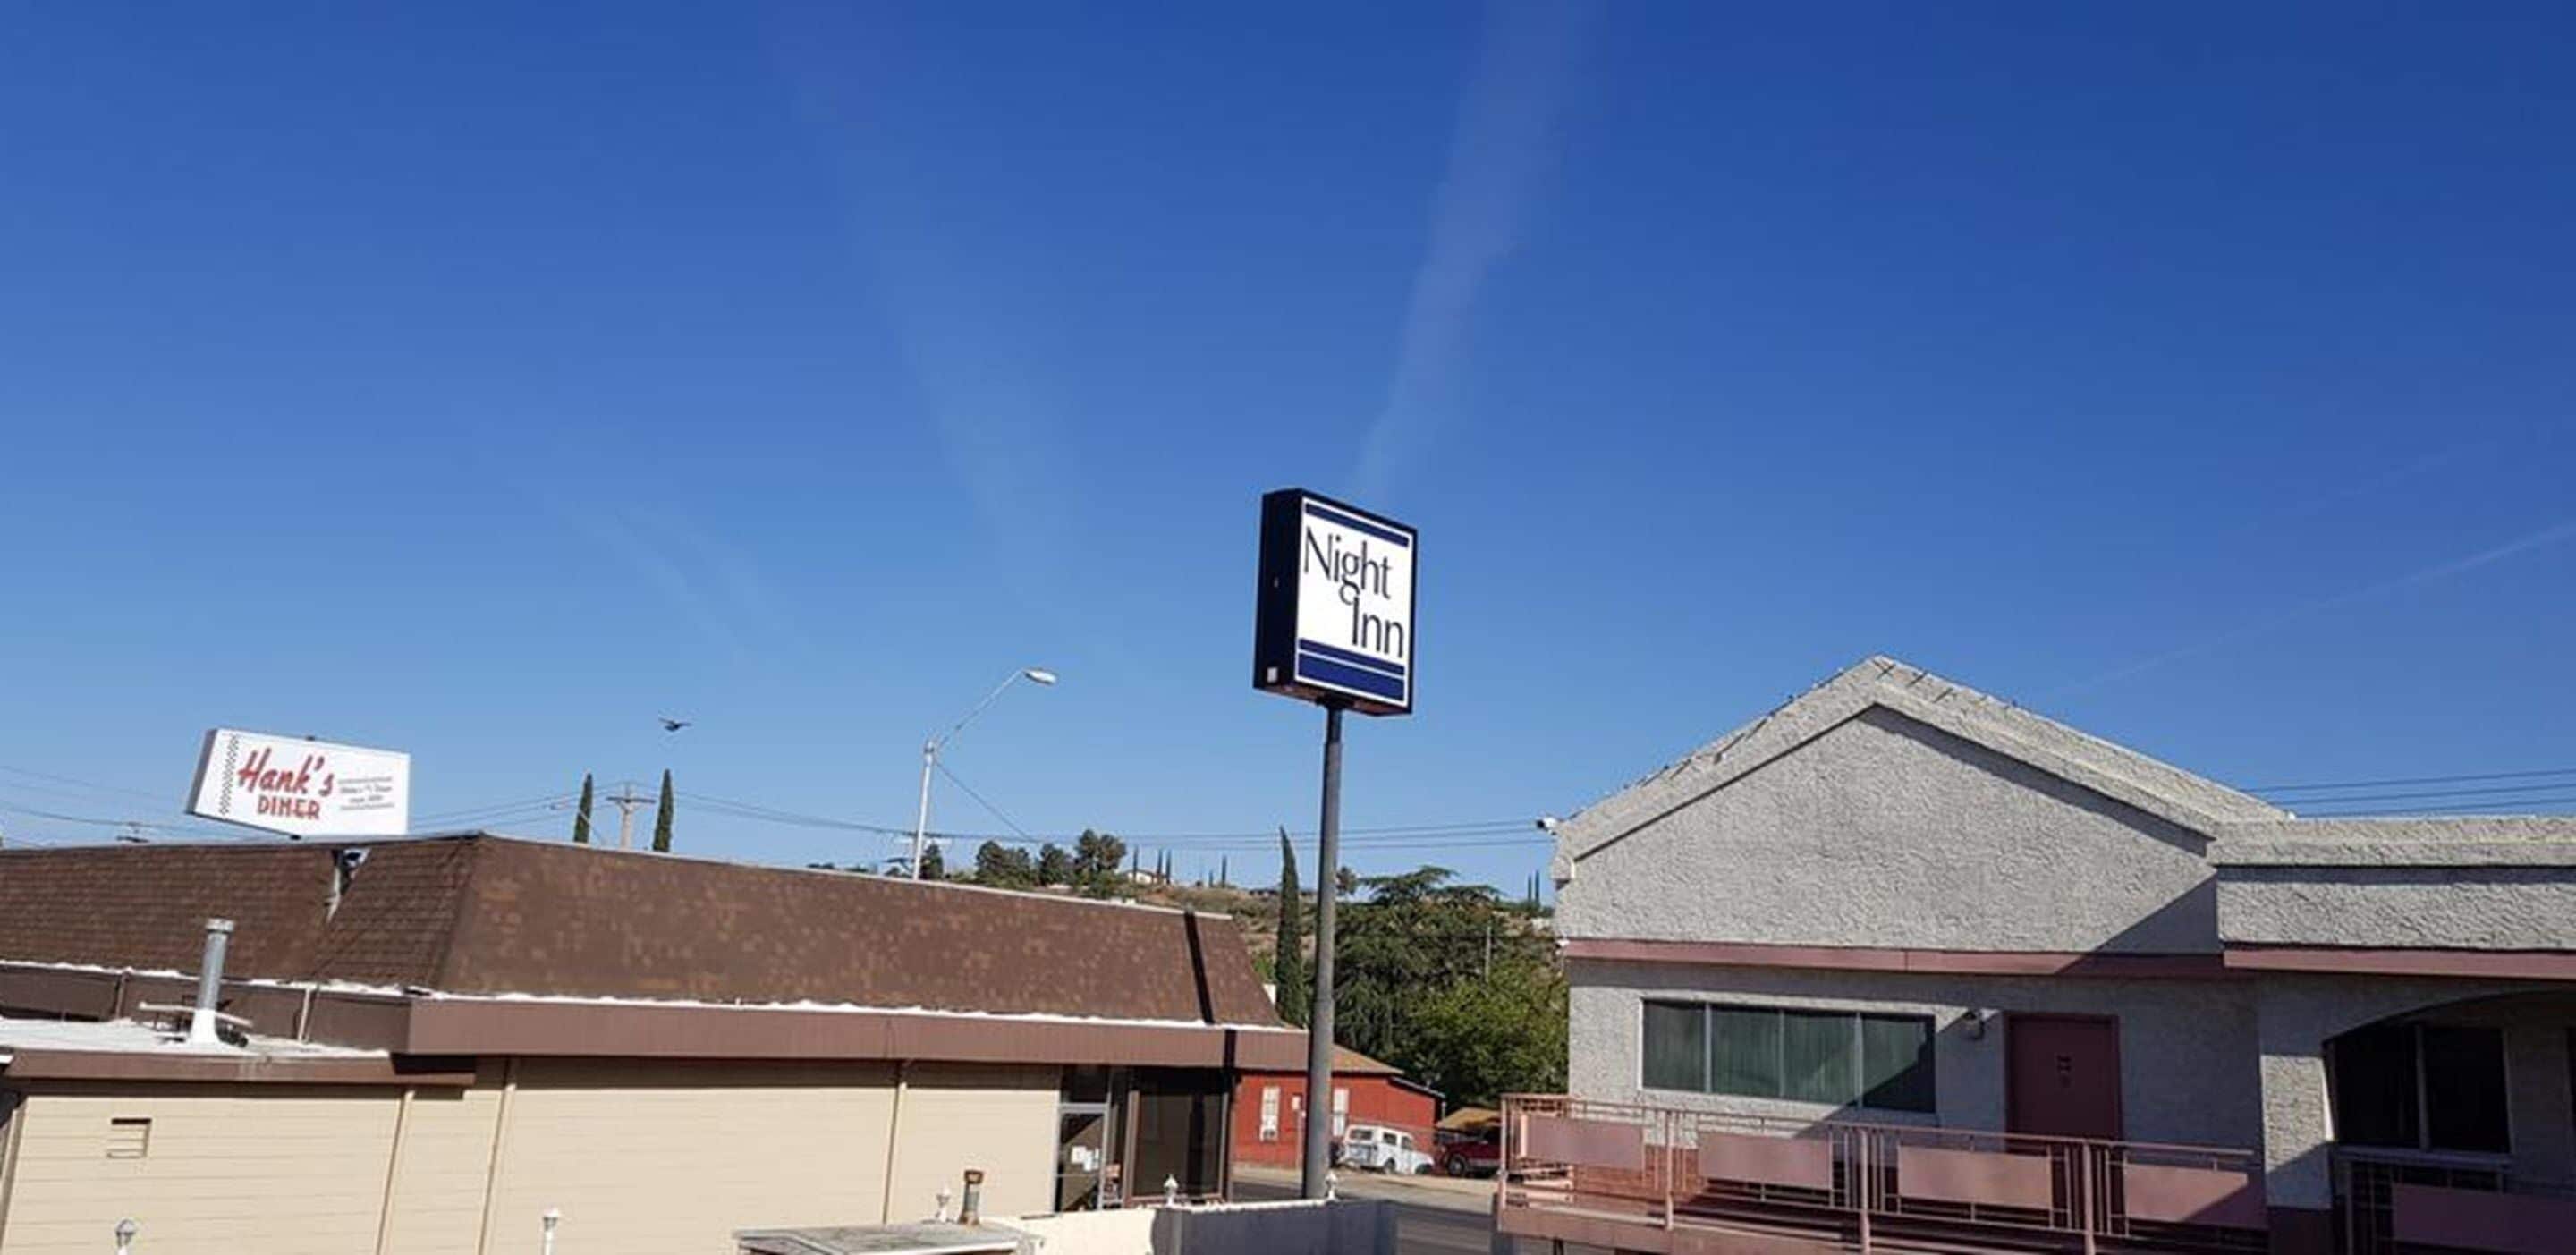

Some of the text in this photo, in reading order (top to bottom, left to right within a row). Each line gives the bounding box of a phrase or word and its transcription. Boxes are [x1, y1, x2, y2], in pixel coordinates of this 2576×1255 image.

[1303, 526, 1392, 606] Night
[1352, 596, 1404, 658] Inn
[237, 748, 335, 796] Hank's
[257, 794, 321, 820] DINER
